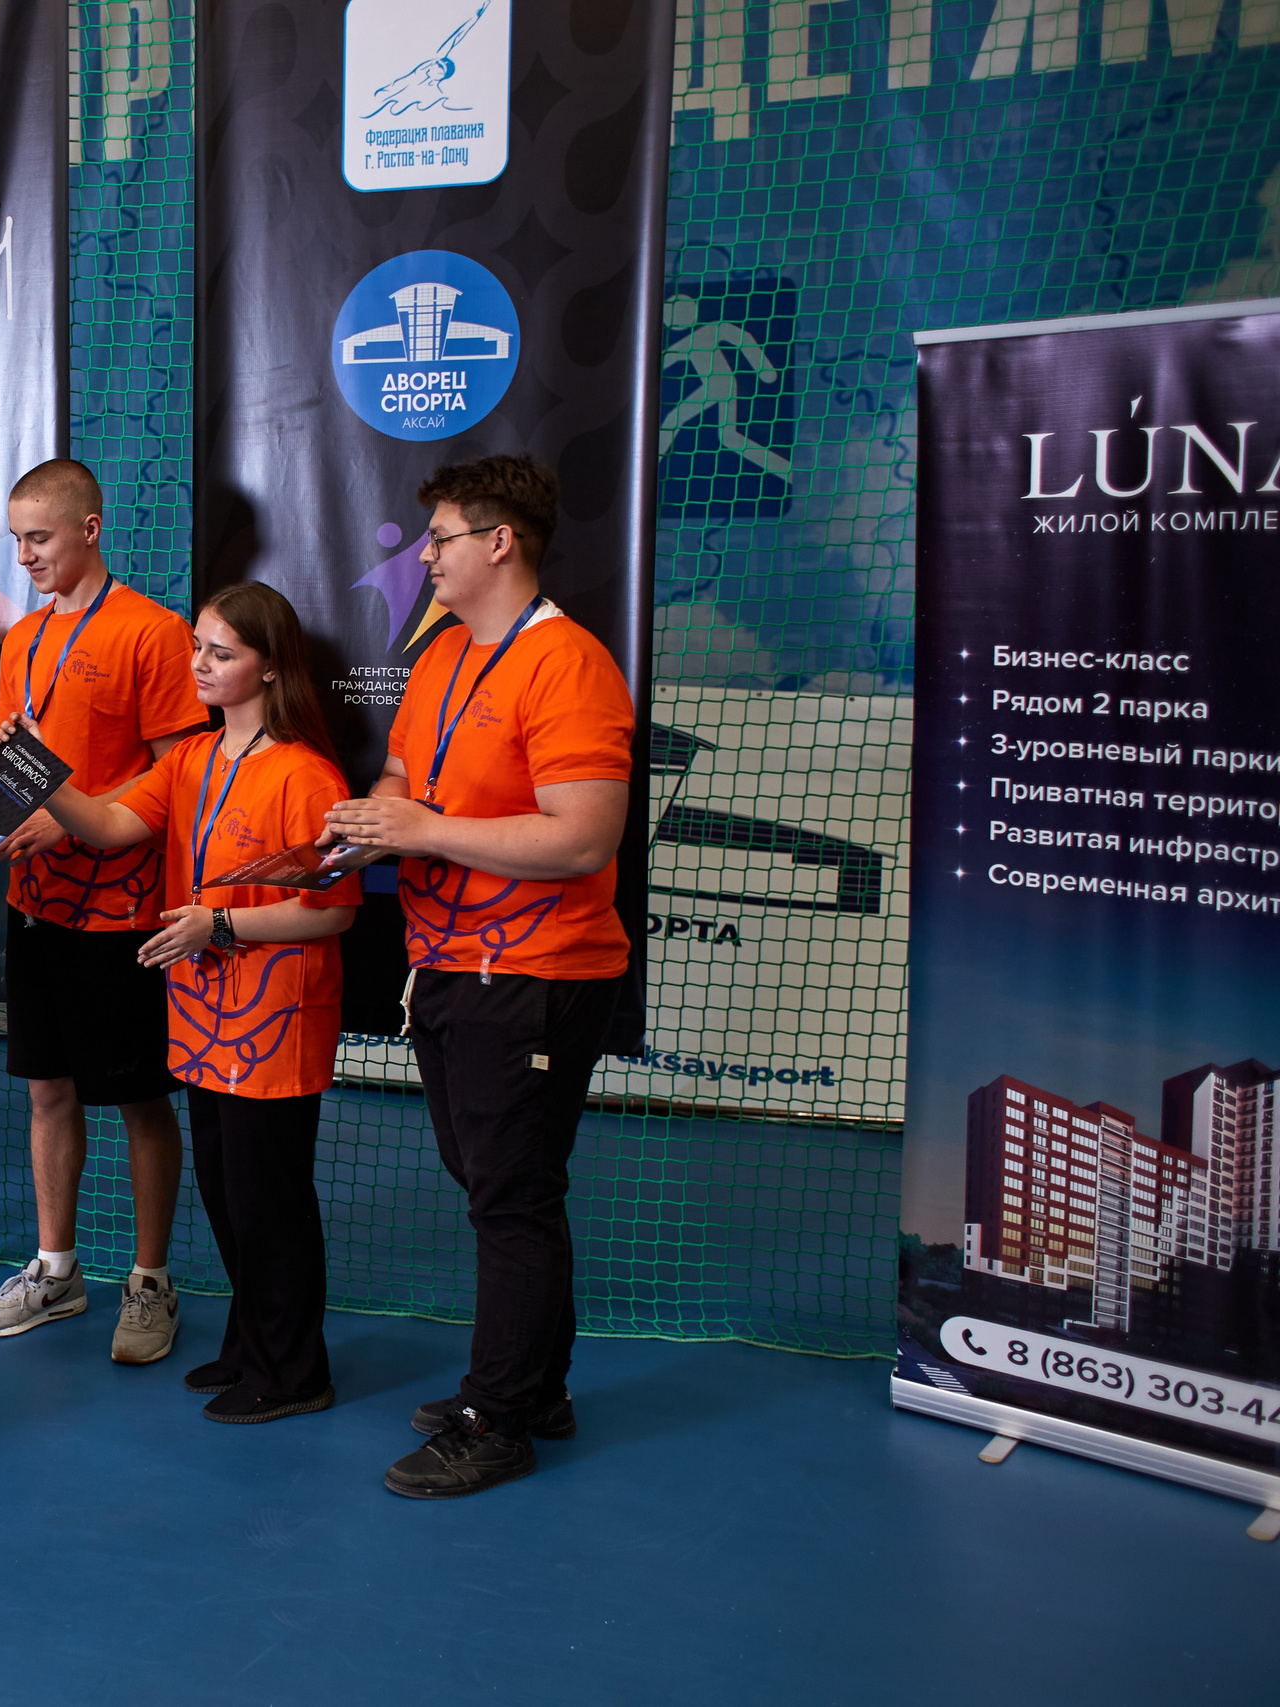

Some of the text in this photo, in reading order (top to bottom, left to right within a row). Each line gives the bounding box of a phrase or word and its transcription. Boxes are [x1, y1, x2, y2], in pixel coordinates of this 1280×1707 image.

[365, 122, 484, 148] Федерация плавания
[365, 146, 469, 170] г. Ростов-на-Дону
[381, 371, 467, 392] ДВОРЕЦ
[380, 392, 467, 413] СПОРТА
[402, 414, 445, 429] АКСАЙ
[1033, 509, 1278, 535] ЖИЛОЙ КОМПЛЕ
[349, 667, 413, 678] АГЕНТСТВ
[993, 645, 1190, 673] Бизнес-класс
[344, 694, 405, 706] РОСТОВС
[992, 689, 1209, 723] Рядом 2 парка
[990, 733, 1182, 766] 3-уровневый
[1, 745, 48, 790] БЛАГОДАРНОСТЬ
[990, 777, 1280, 827] Приватная террито
[989, 820, 1280, 872] Развитая инфрастр
[988, 863, 1187, 903] Современная
[1007, 1340, 1029, 1366] 8
[1041, 1347, 1135, 1400] (863)
